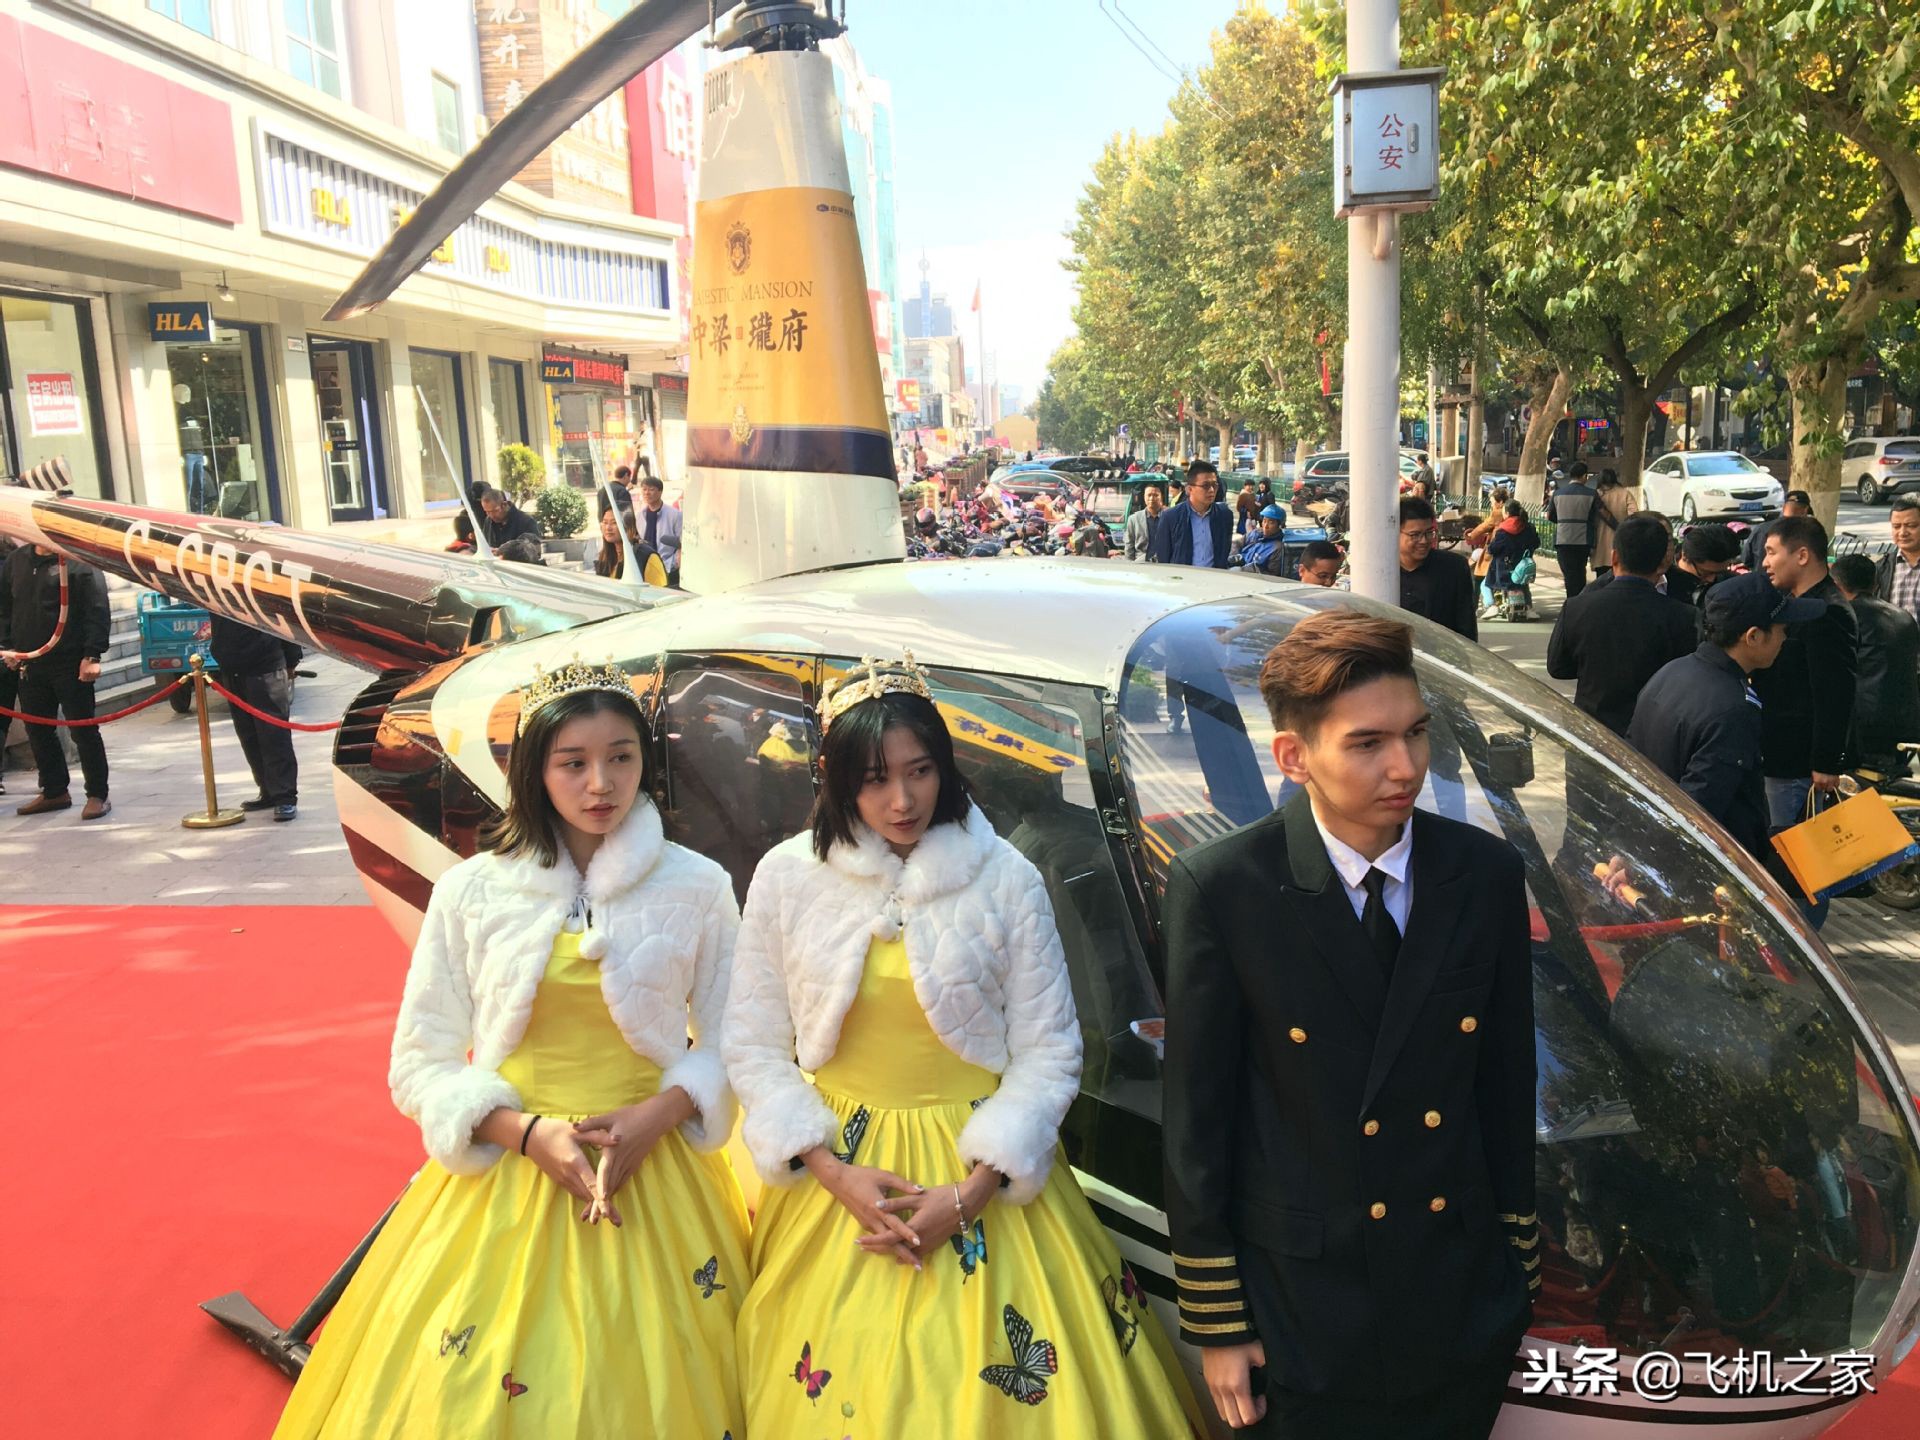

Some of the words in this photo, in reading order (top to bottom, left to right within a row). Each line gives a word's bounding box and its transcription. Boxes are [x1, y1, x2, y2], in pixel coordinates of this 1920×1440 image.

[1377, 113, 1404, 171] 公安
[313, 188, 351, 228] HLA
[741, 281, 814, 302] MANSION
[156, 313, 205, 331] HLA
[693, 312, 732, 361] 中梁
[544, 366, 572, 378] HLA
